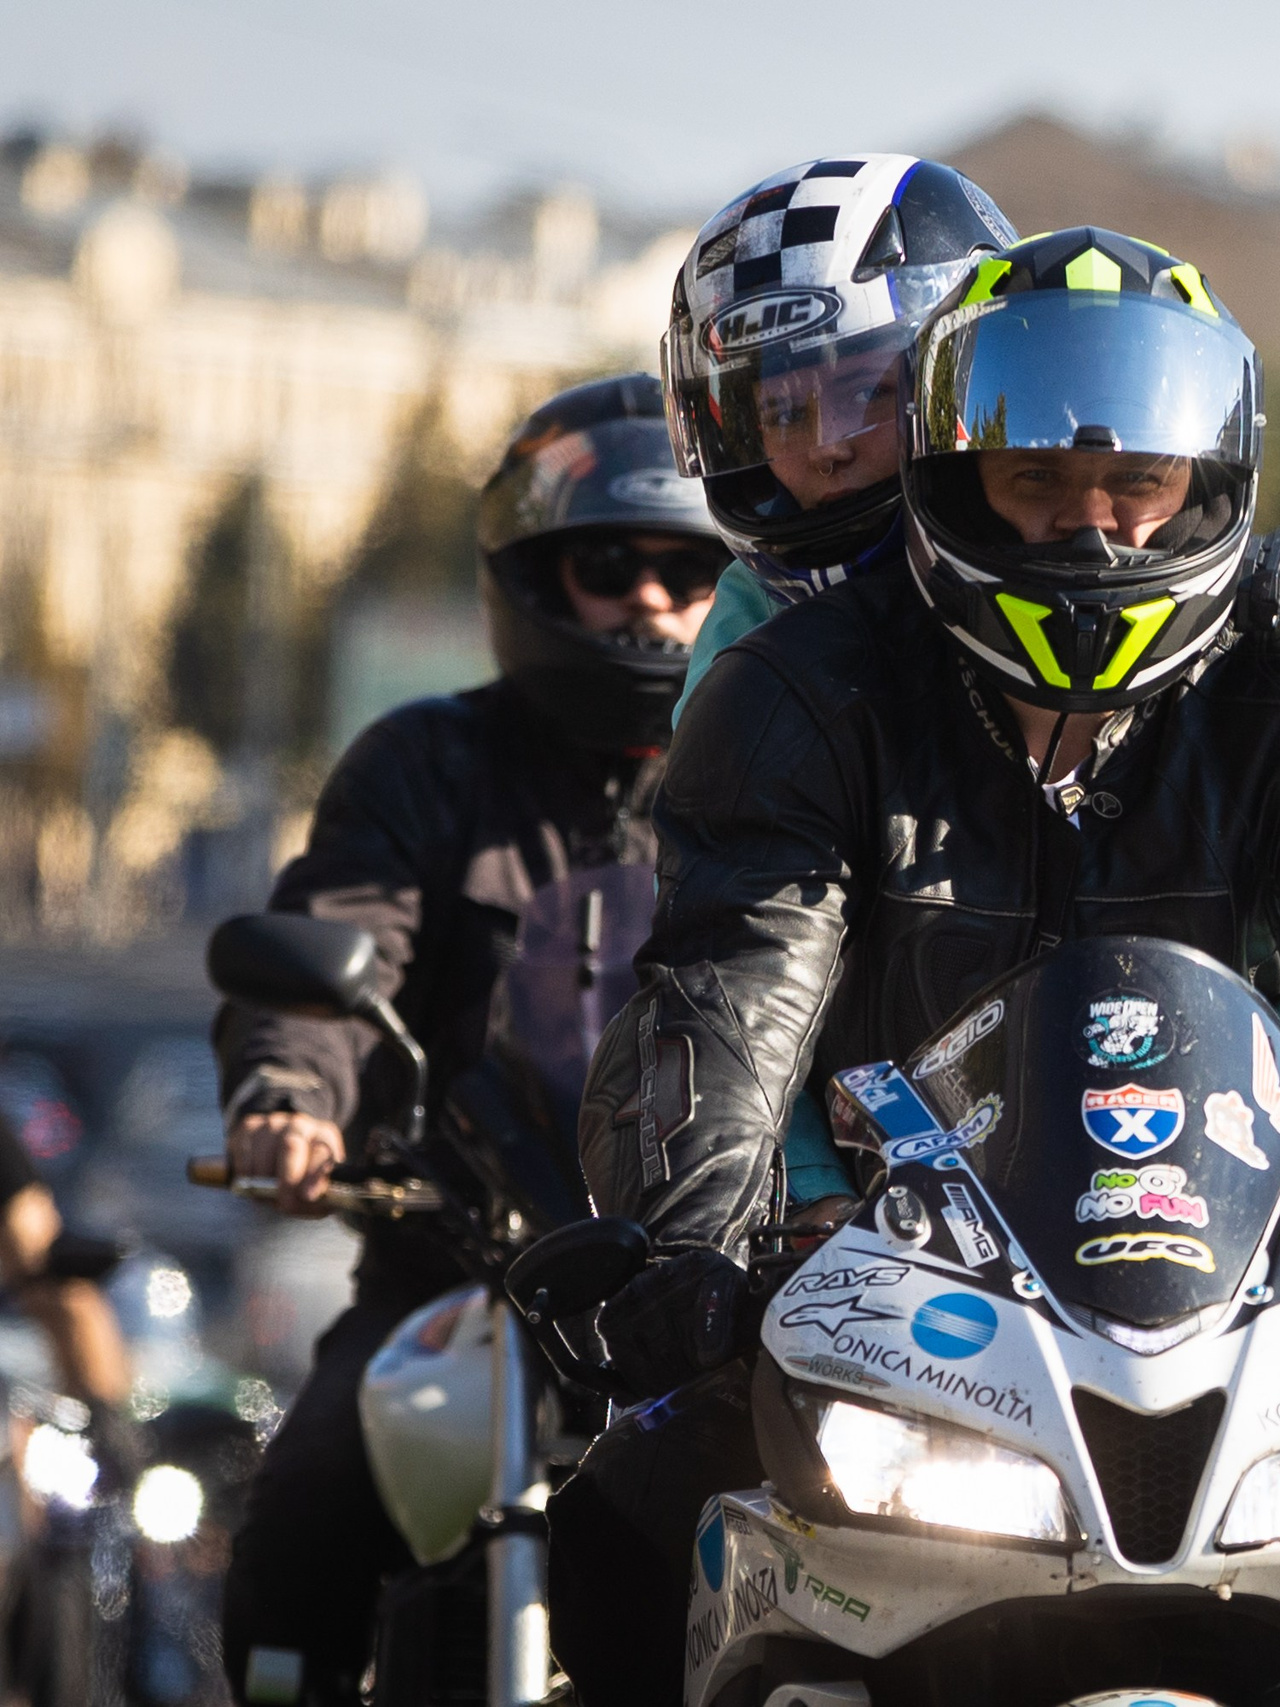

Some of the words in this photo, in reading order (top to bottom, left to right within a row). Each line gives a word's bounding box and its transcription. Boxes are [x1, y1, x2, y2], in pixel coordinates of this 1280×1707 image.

[717, 295, 813, 345] HJC
[918, 1002, 1001, 1075] OGIO
[1085, 1093, 1178, 1109] RACER
[913, 1116, 984, 1151] AFAM
[1109, 1110, 1158, 1142] X
[1095, 1173, 1137, 1190] NO
[1079, 1193, 1133, 1219] NO
[1140, 1193, 1203, 1223] FUN
[960, 1207, 994, 1260] AMG
[1081, 1240, 1203, 1260] UFO
[783, 1266, 910, 1297] RAYS
[808, 1358, 864, 1386] WORKS
[833, 1333, 911, 1378] ONICA
[916, 1364, 1034, 1428] MINOLTA
